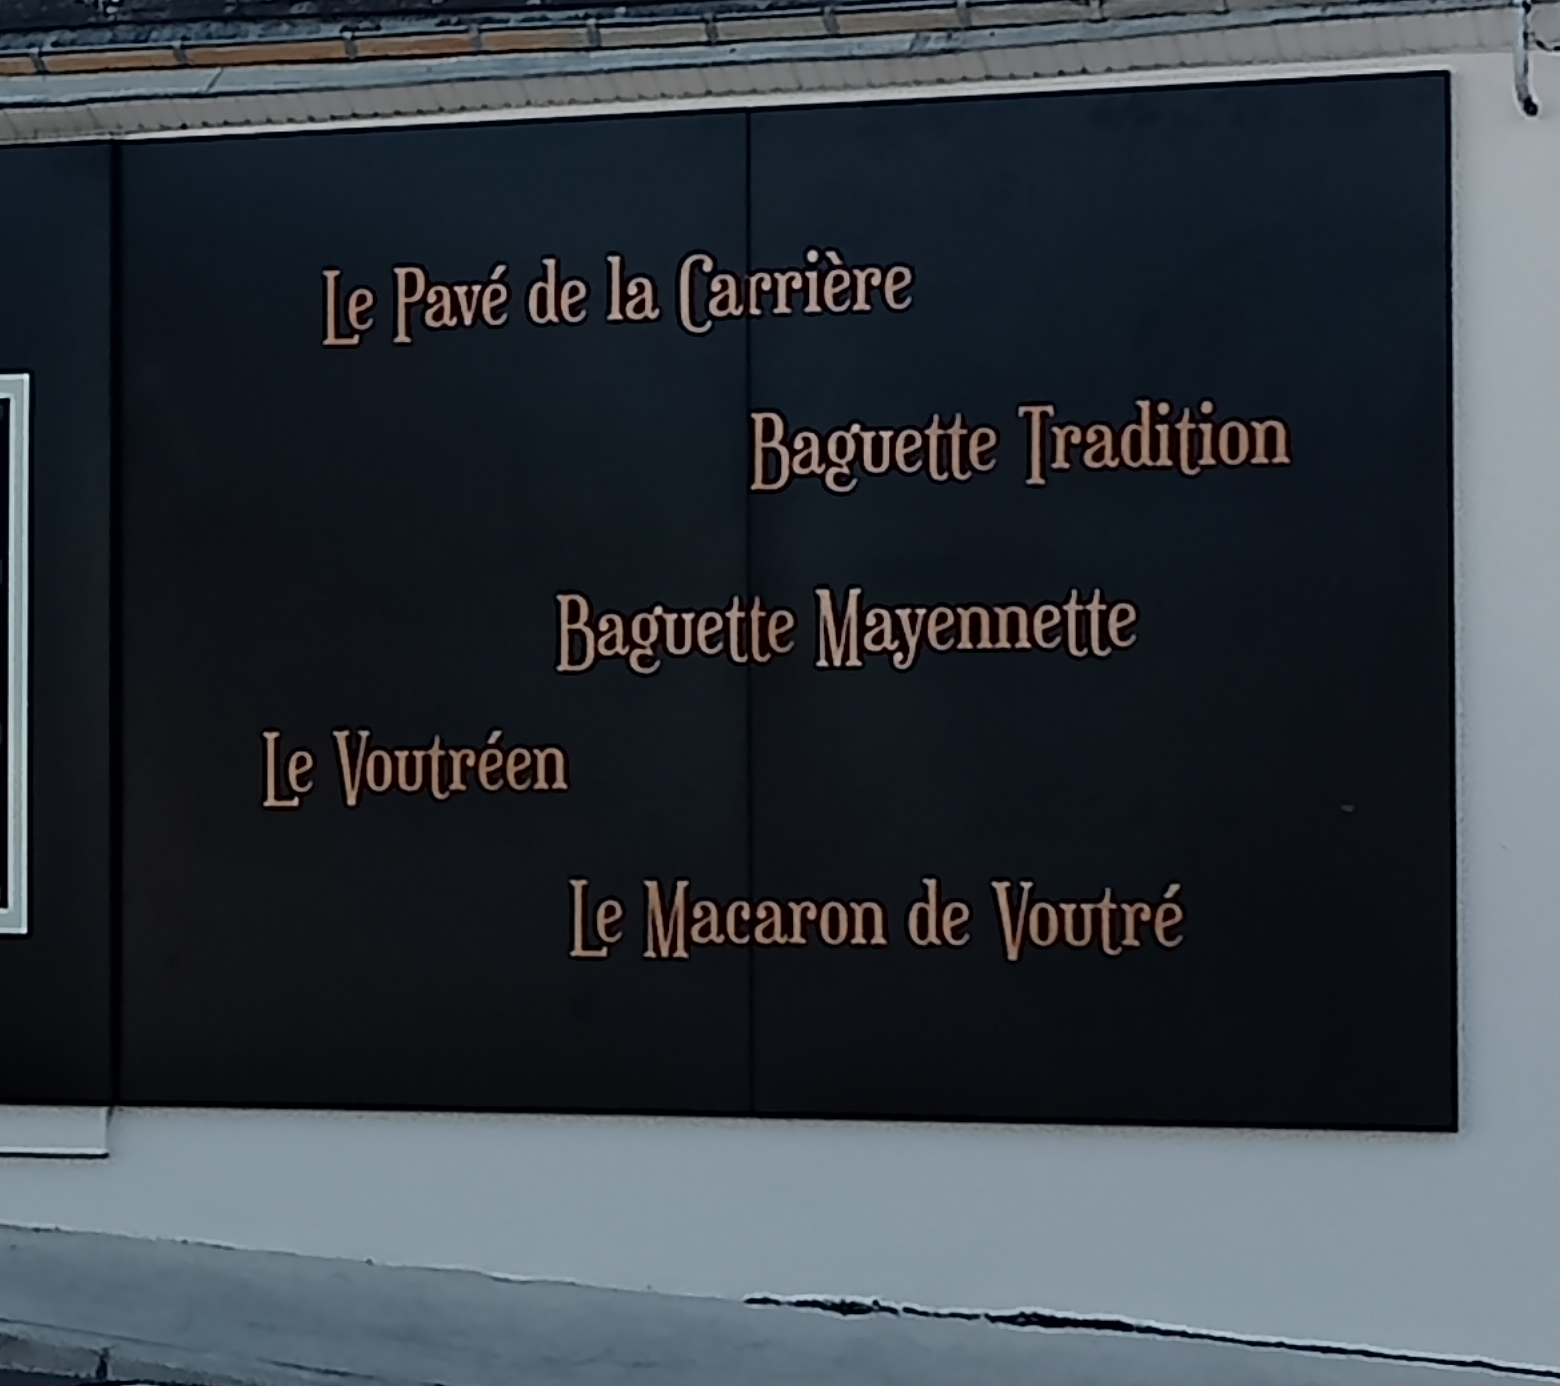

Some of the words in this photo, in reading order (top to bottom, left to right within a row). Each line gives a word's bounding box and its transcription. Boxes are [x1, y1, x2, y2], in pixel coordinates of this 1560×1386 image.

[322, 269, 376, 347] Le
[392, 265, 510, 344] Pavé
[528, 256, 587, 325] de
[606, 257, 660, 322] la
[678, 248, 915, 334] Carrière
[749, 411, 998, 491] Baguette
[1018, 400, 1292, 487] Tradition
[555, 593, 796, 674] Baguette
[815, 587, 1139, 670] Mayennette
[262, 731, 315, 809] Le
[332, 729, 569, 807] Voutréen
[569, 879, 624, 959] Le
[644, 879, 888, 960] Macaron
[906, 879, 972, 947] de
[991, 882, 1185, 962] Voutré
